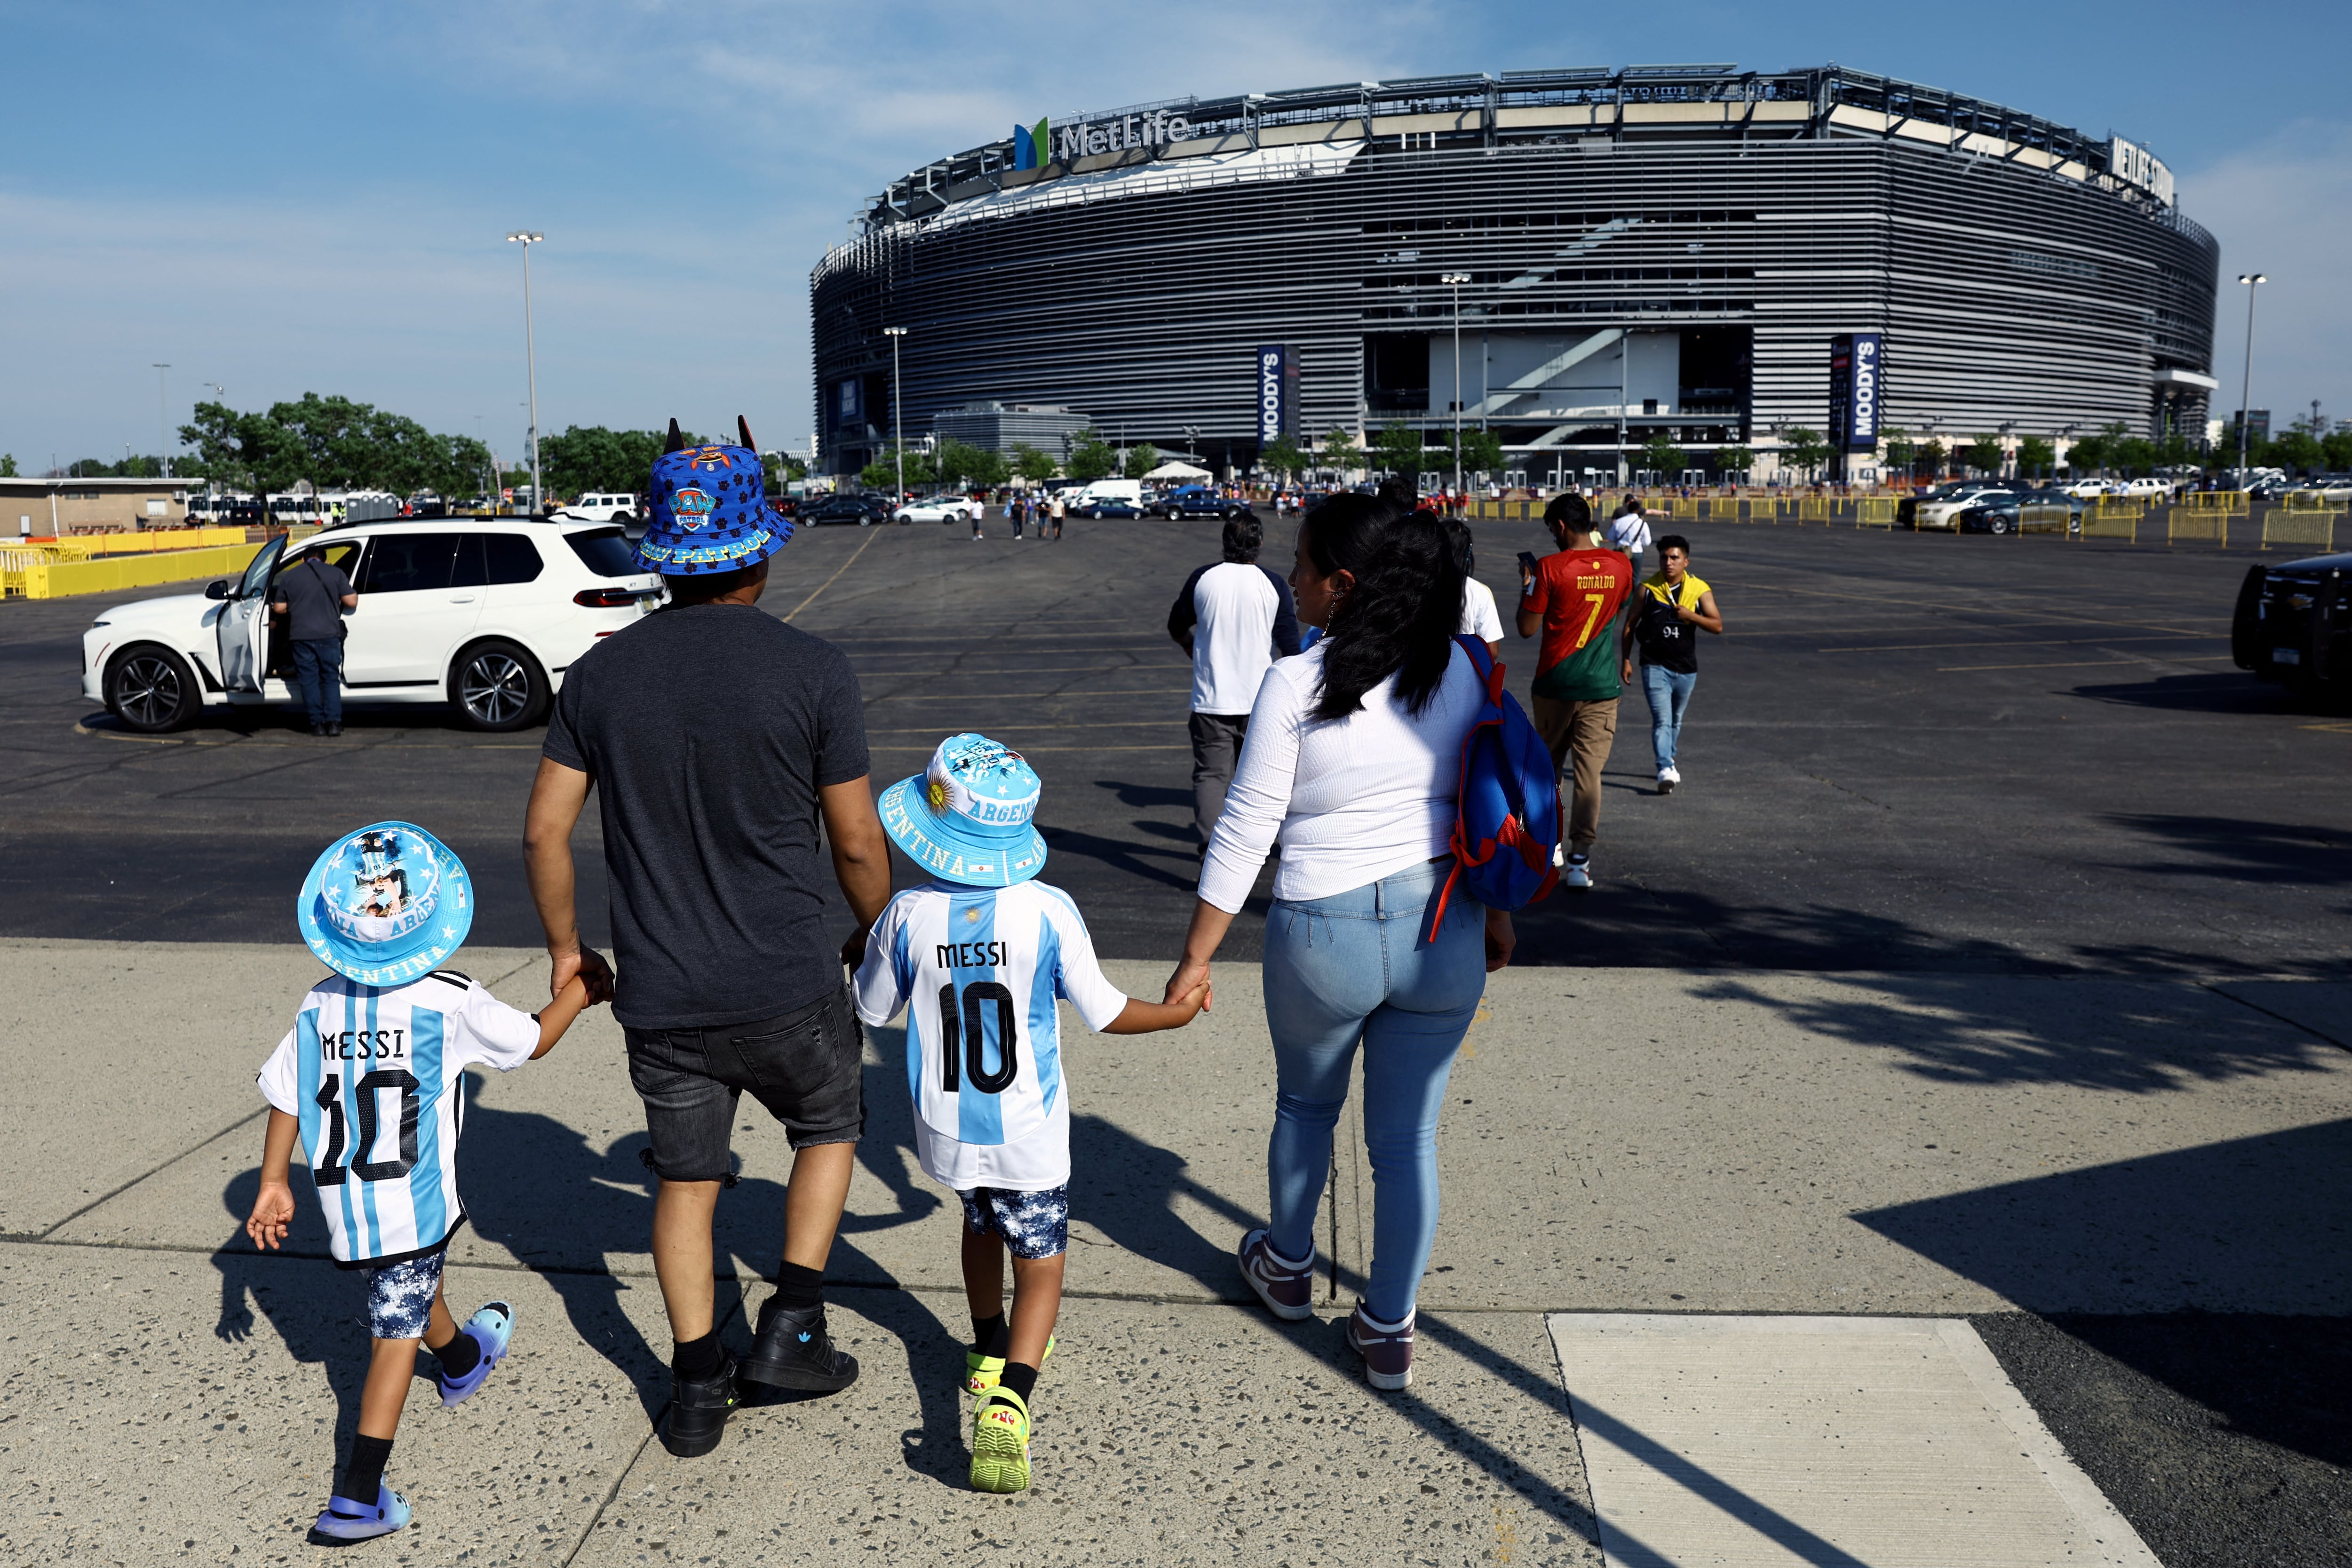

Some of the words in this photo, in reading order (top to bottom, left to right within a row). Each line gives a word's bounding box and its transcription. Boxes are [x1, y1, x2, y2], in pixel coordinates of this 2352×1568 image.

[1061, 109, 1189, 159] MetLife
[1263, 353, 1279, 442] MOODY'S
[1855, 341, 1875, 437] MOODY'S
[668, 494, 716, 515] PAW
[672, 529, 771, 563] PATROL
[1577, 575, 1615, 590] RONALDO
[1575, 593, 1605, 649] 7
[1662, 626, 1680, 638] 94
[309, 937, 449, 984] ARGENTINA
[937, 941, 1007, 969] MESSI
[322, 1029, 404, 1060] MESSI
[938, 981, 1017, 1094] 10
[313, 1069, 420, 1187] 10
